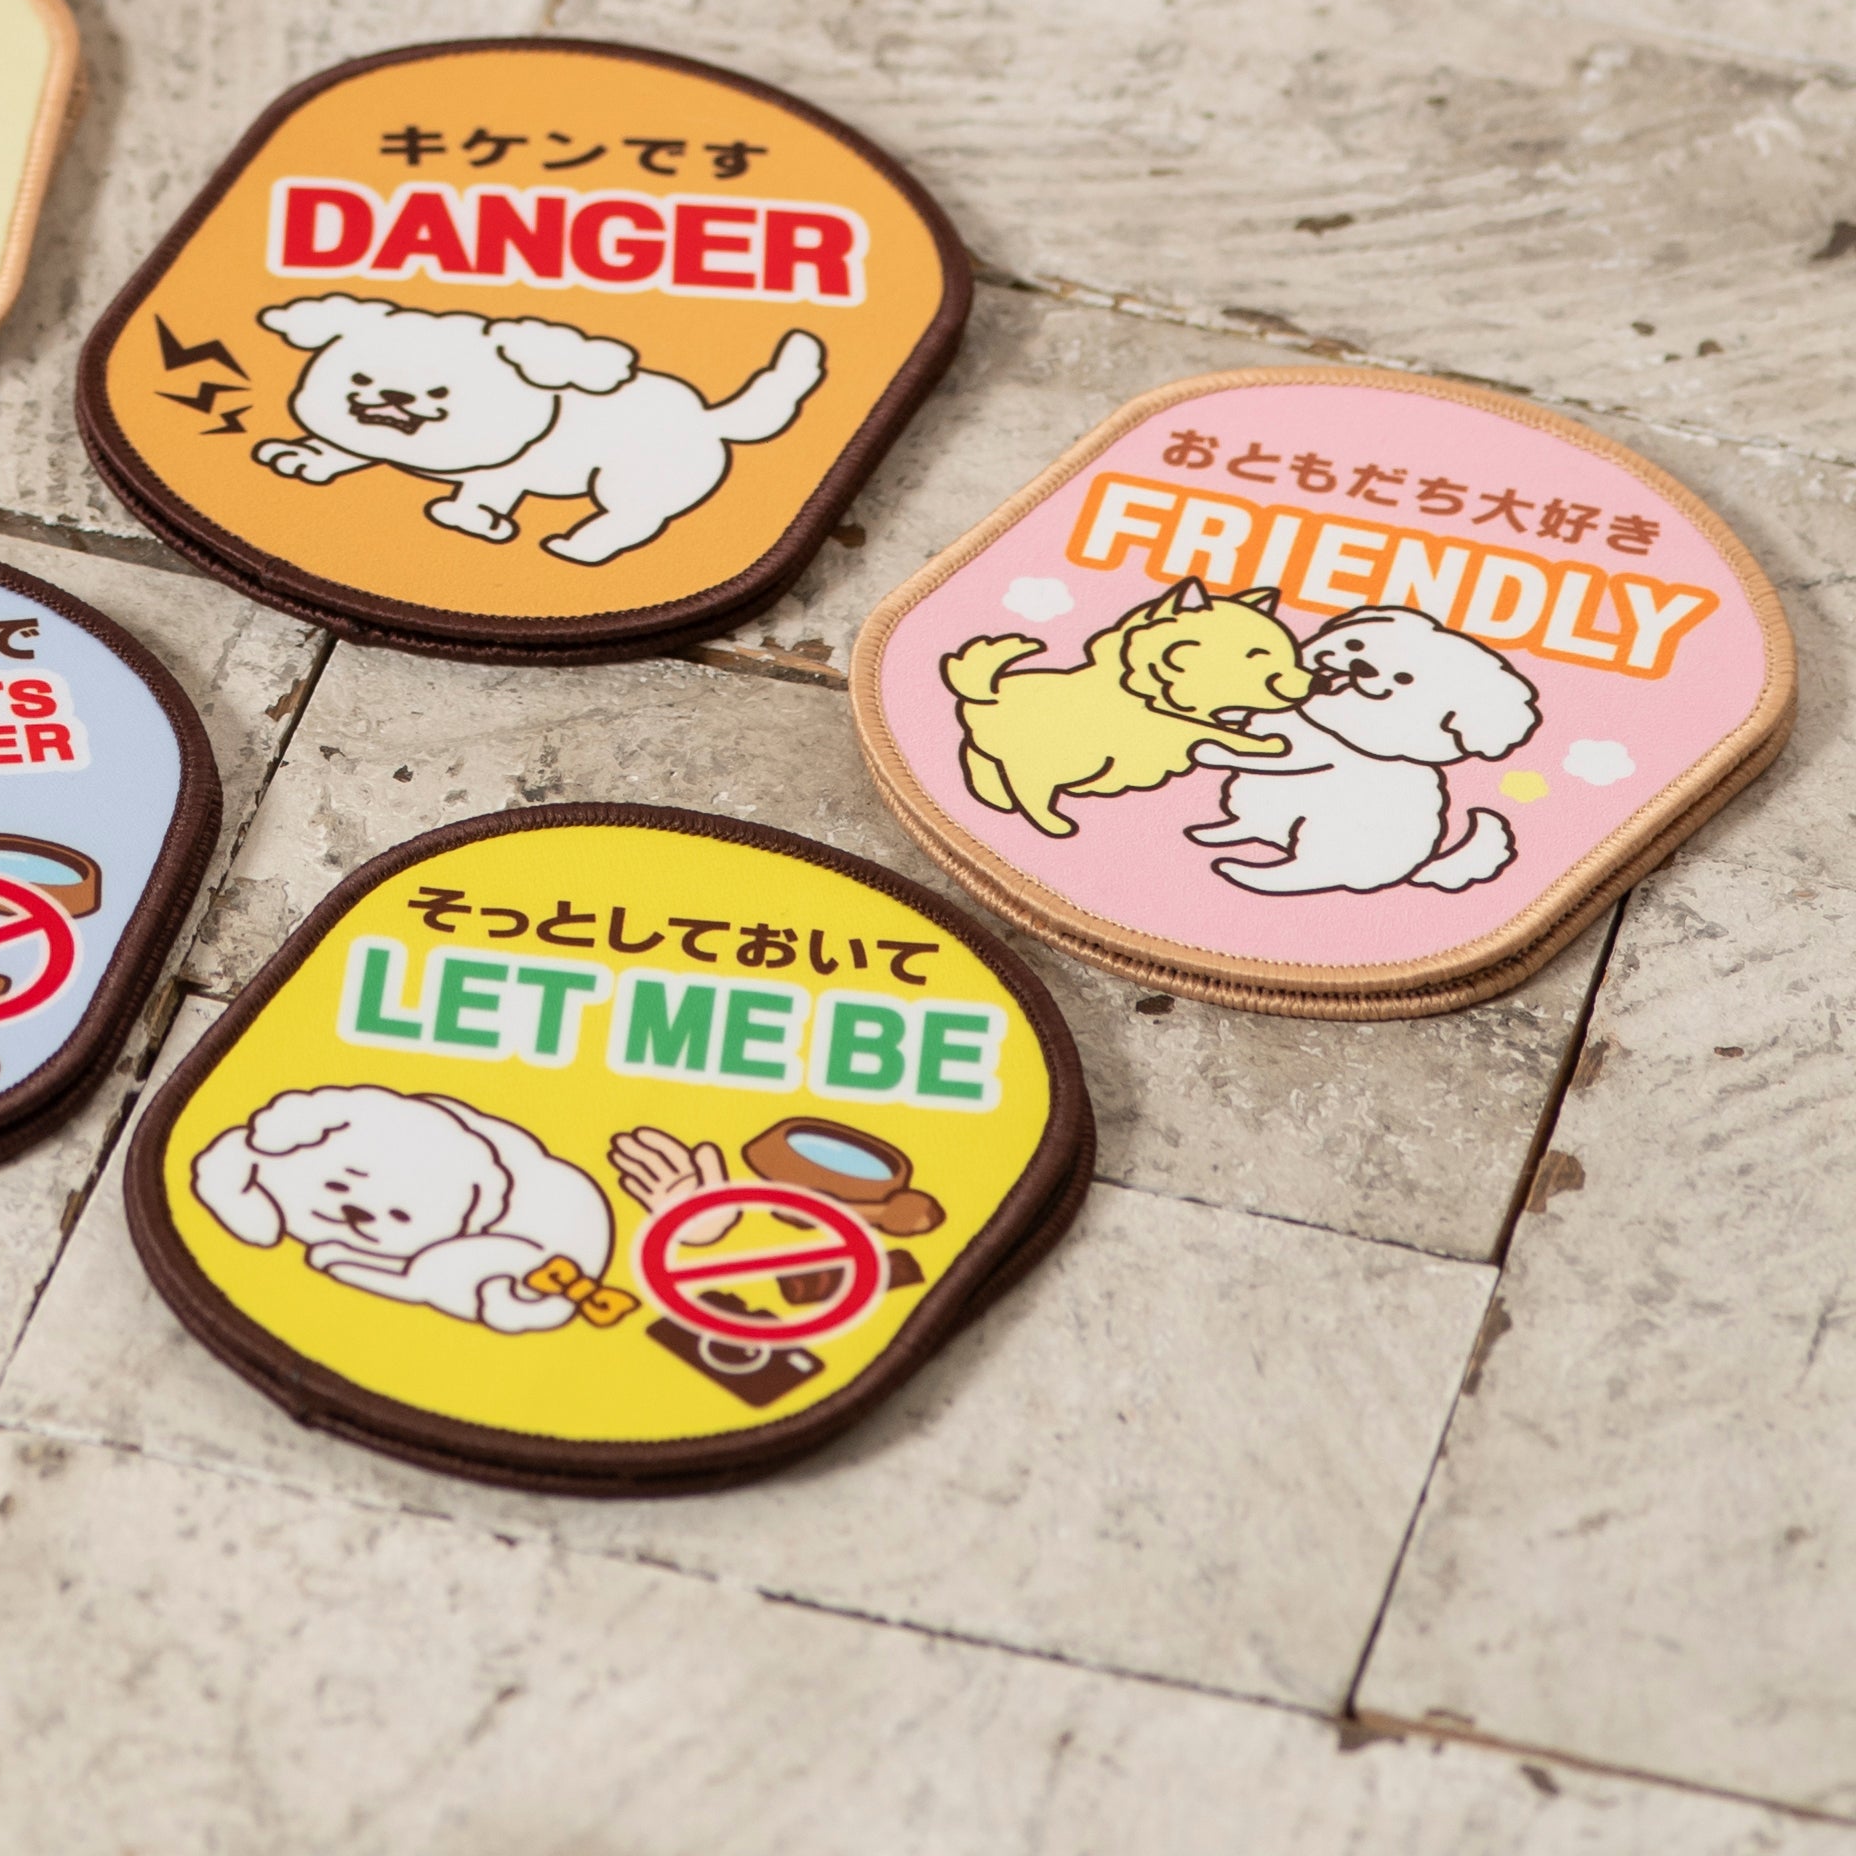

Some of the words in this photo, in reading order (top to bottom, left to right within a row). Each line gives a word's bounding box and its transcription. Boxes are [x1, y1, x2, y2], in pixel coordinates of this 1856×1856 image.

[380, 125, 768, 178] キケンです
[281, 187, 855, 297] DANGER
[1161, 429, 1662, 556] おともだち大好き
[1080, 487, 1708, 670] FRIENDLY
[408, 886, 940, 986] そっとしておいて
[354, 947, 595, 1055] LET
[623, 979, 795, 1079] ME
[823, 1002, 990, 1099] BE
